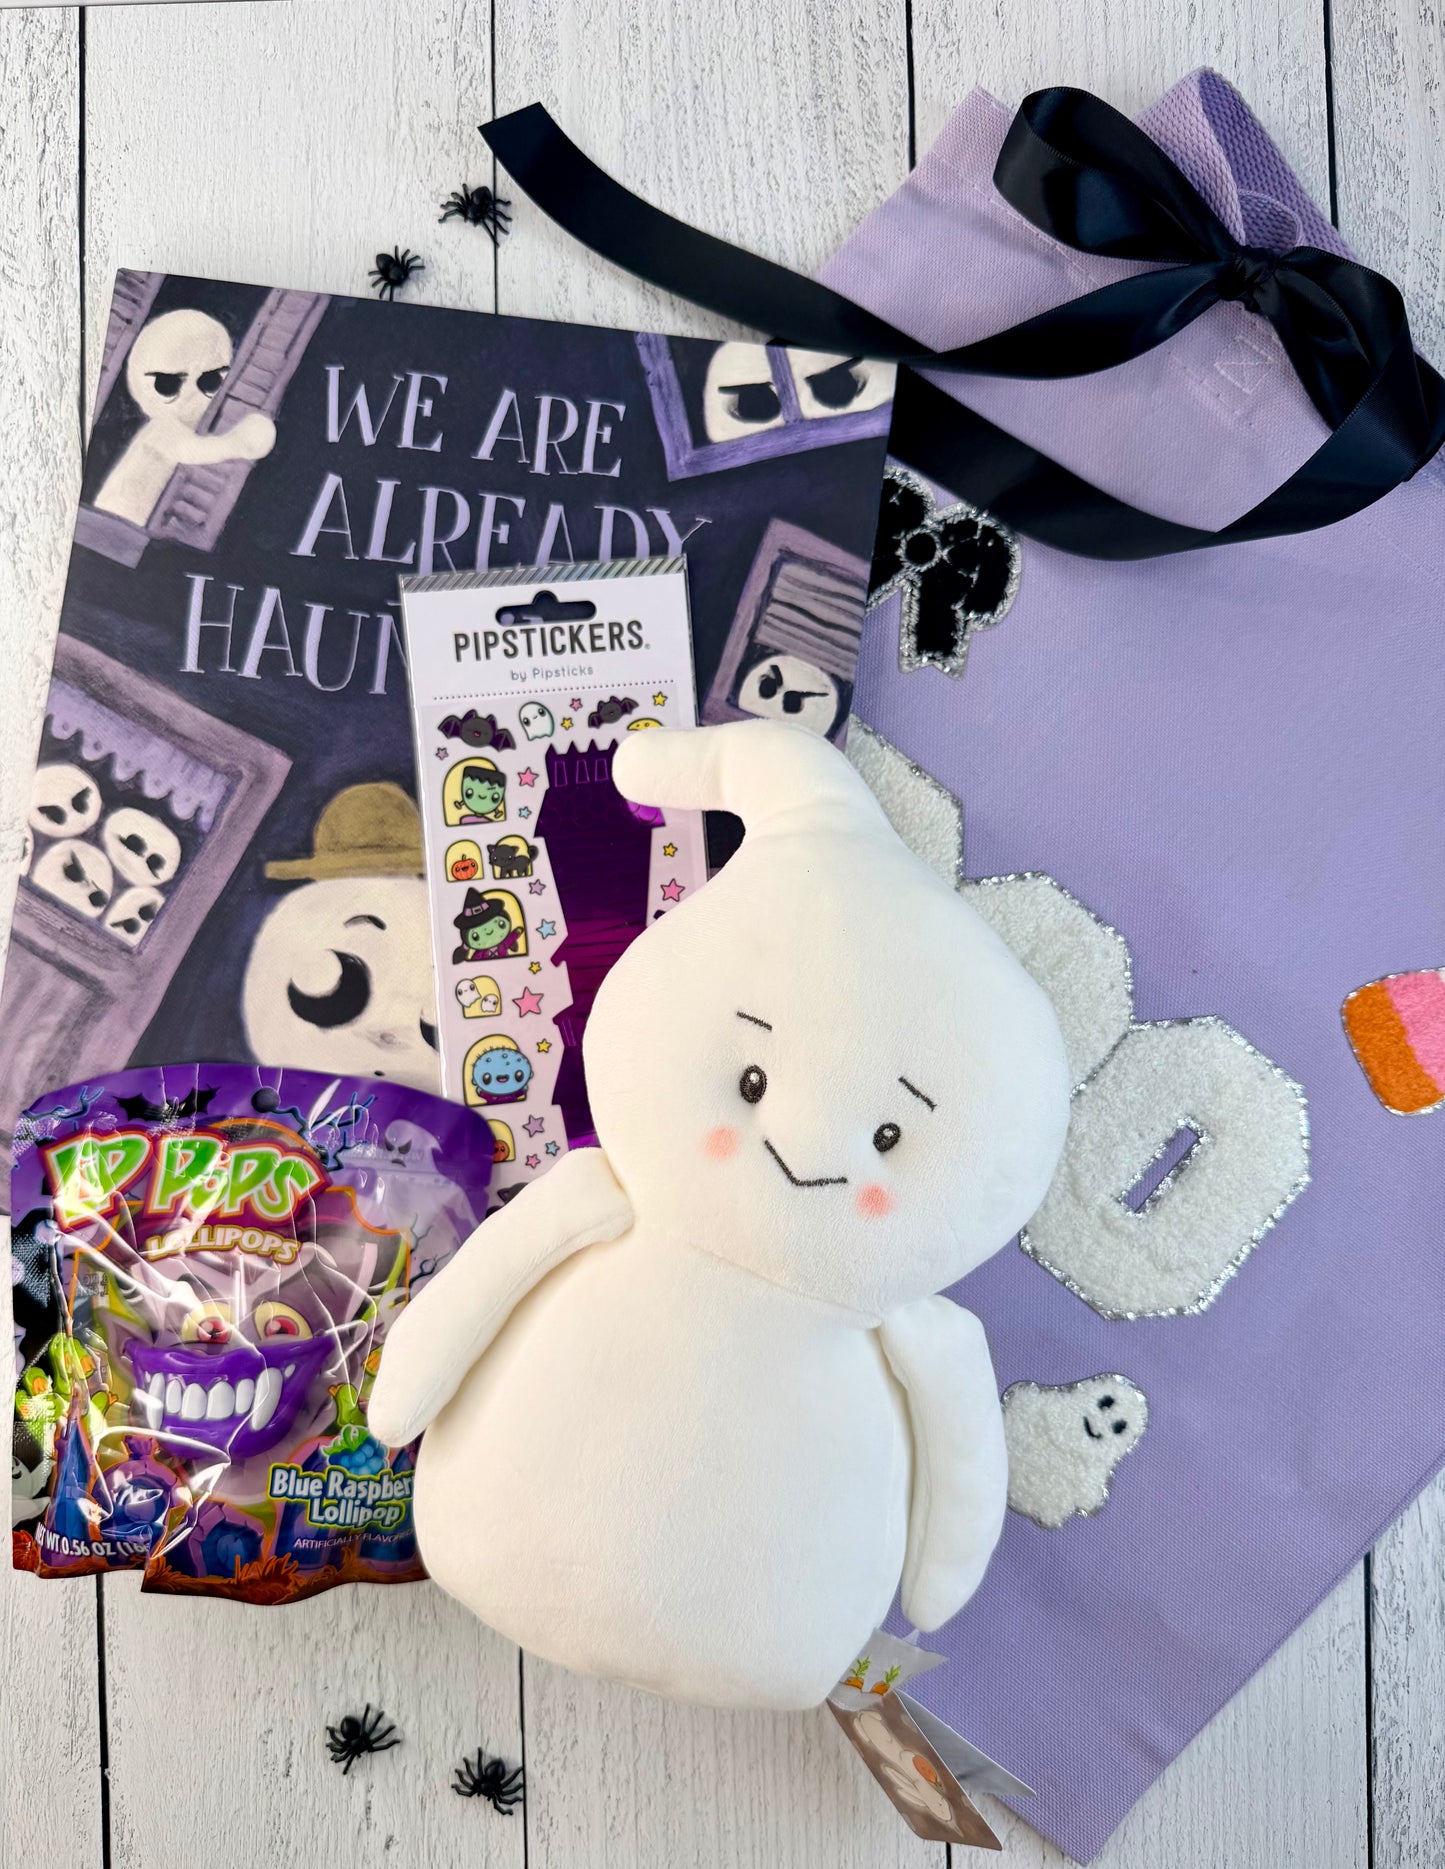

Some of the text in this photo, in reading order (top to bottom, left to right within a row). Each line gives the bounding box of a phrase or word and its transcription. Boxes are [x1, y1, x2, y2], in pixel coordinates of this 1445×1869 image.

[326, 365, 626, 477] WE ARE
[290, 472, 712, 576] ALREADY
[179, 571, 408, 695] HAUN
[511, 665, 594, 682] by Pipsticks
[149, 1225, 299, 1262] LOLLIPOPS
[272, 1468, 415, 1505] Blue Raspber
[311, 1498, 400, 1527] Lollipop
[46, 1530, 60, 1552] WT
[61, 1537, 90, 1556] 0.56
[92, 1541, 116, 1556] OZ
